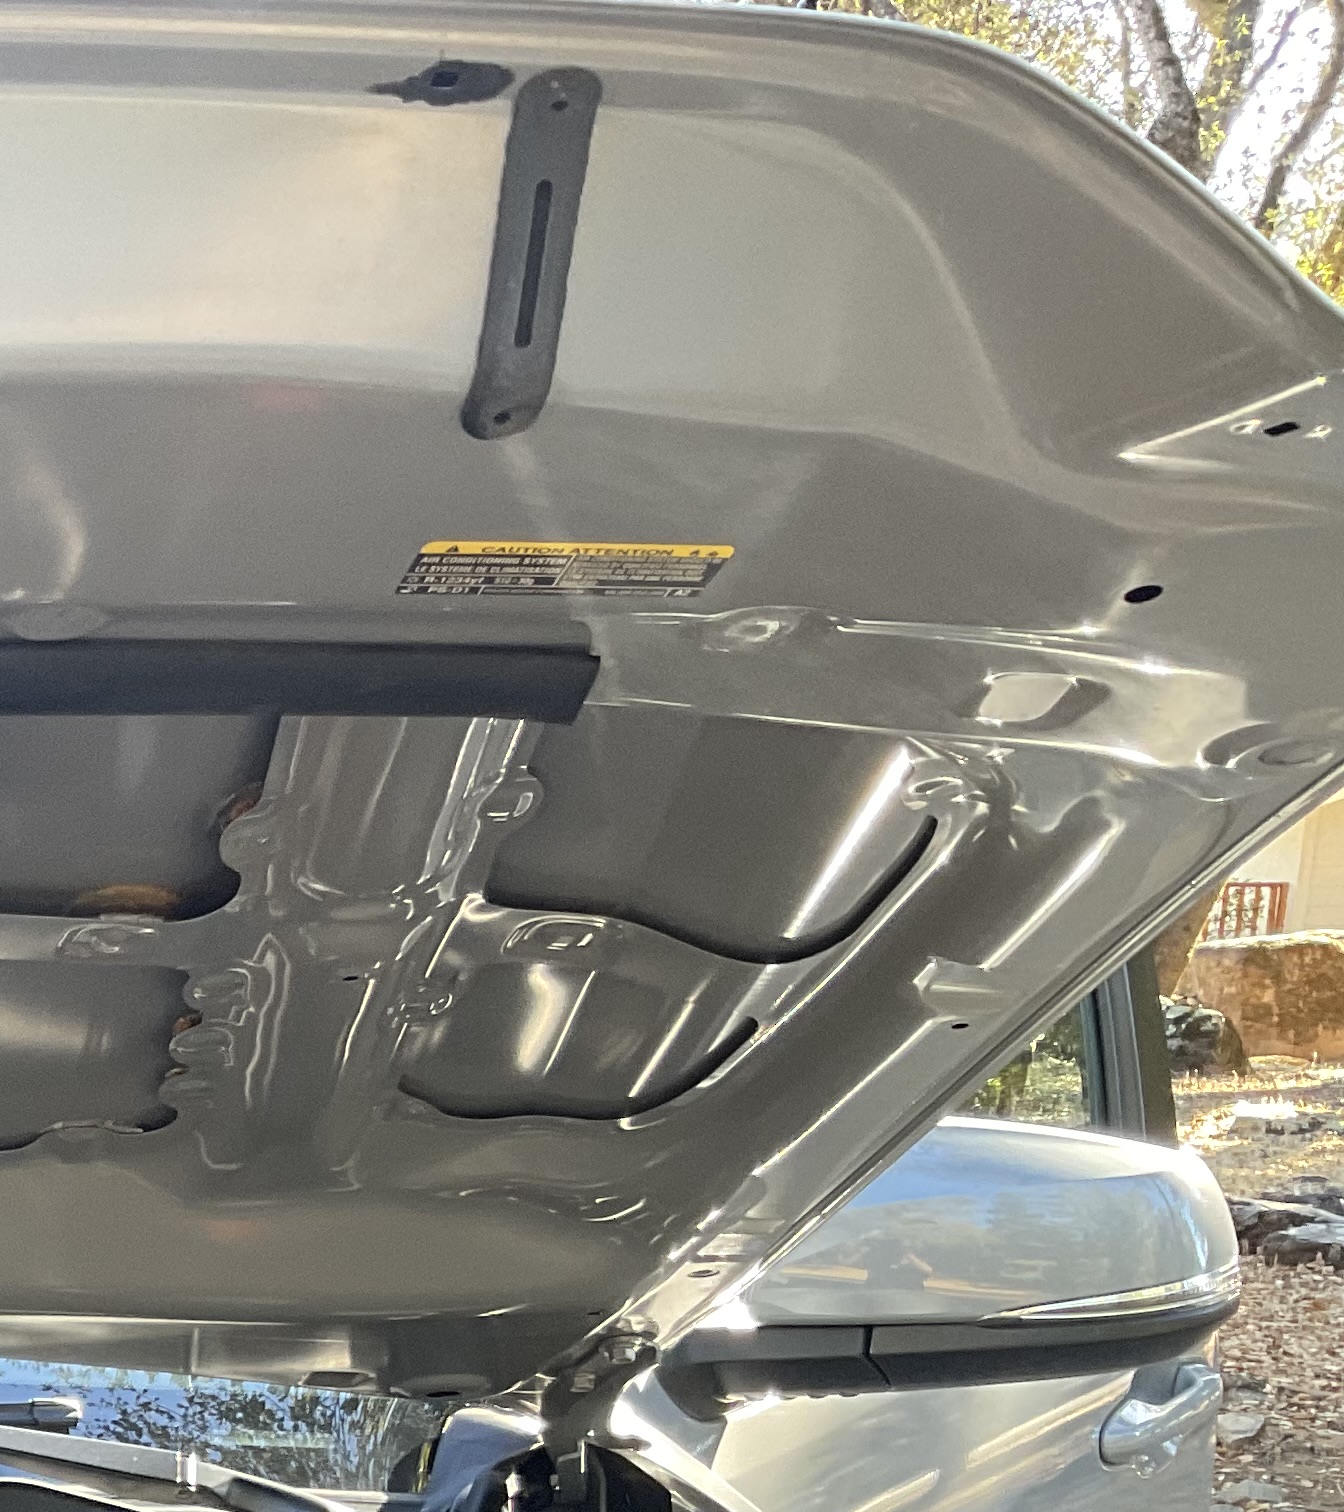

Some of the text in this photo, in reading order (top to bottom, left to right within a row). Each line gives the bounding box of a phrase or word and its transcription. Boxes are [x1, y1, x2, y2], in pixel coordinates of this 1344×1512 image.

[480, 546, 675, 556] CAUTION ATTENTION
[419, 556, 441, 564] AIR
[442, 556, 521, 564] CONDITIONING
[523, 556, 568, 564] SYSTEM
